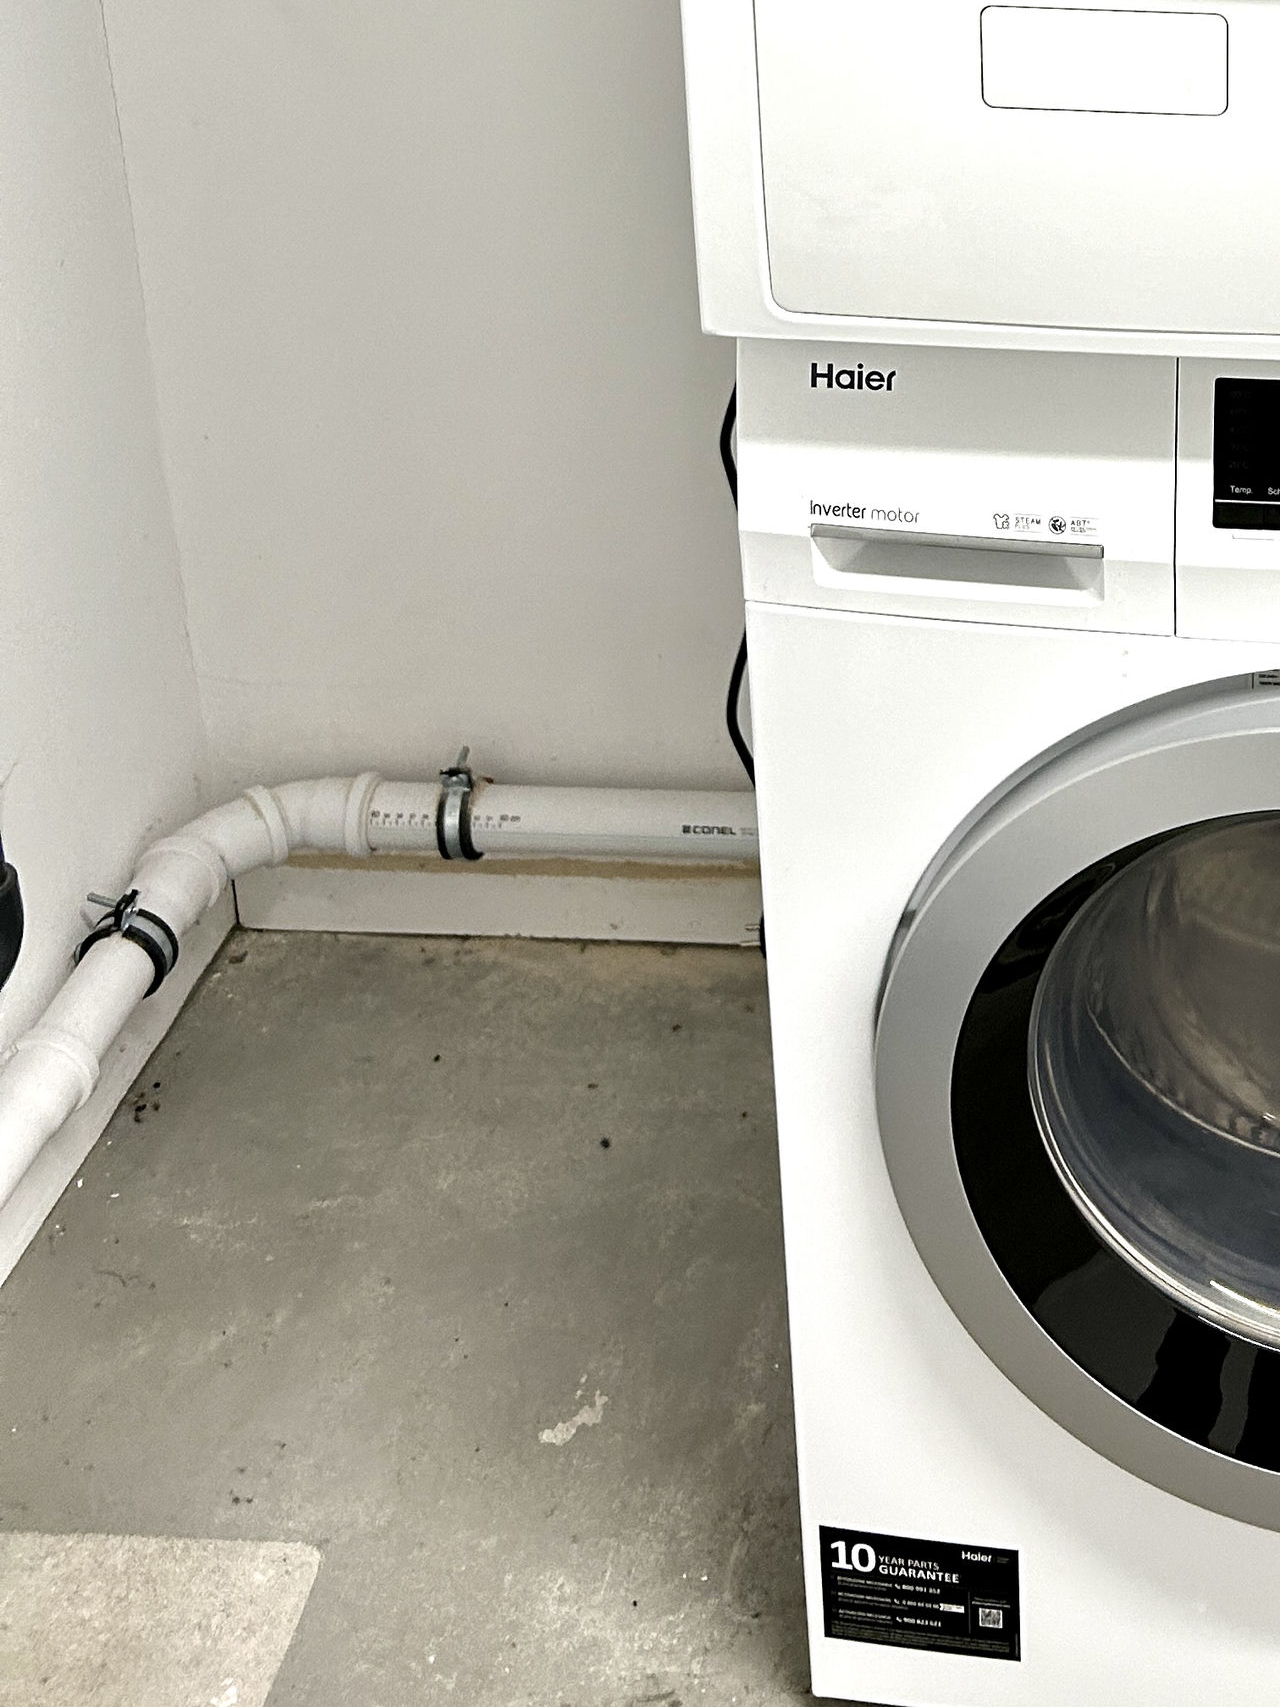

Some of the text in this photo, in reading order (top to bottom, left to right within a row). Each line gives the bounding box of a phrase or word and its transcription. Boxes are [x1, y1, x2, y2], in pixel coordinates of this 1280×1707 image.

[810, 363, 896, 391] Haier
[810, 499, 920, 523] Inverter motor
[1015, 516, 1042, 525] STEAM
[830, 1540, 876, 1573] 10
[879, 1555, 939, 1571] YEAR PARTS
[961, 1550, 992, 1563] Haier
[878, 1565, 960, 1584] GUARANTEE
